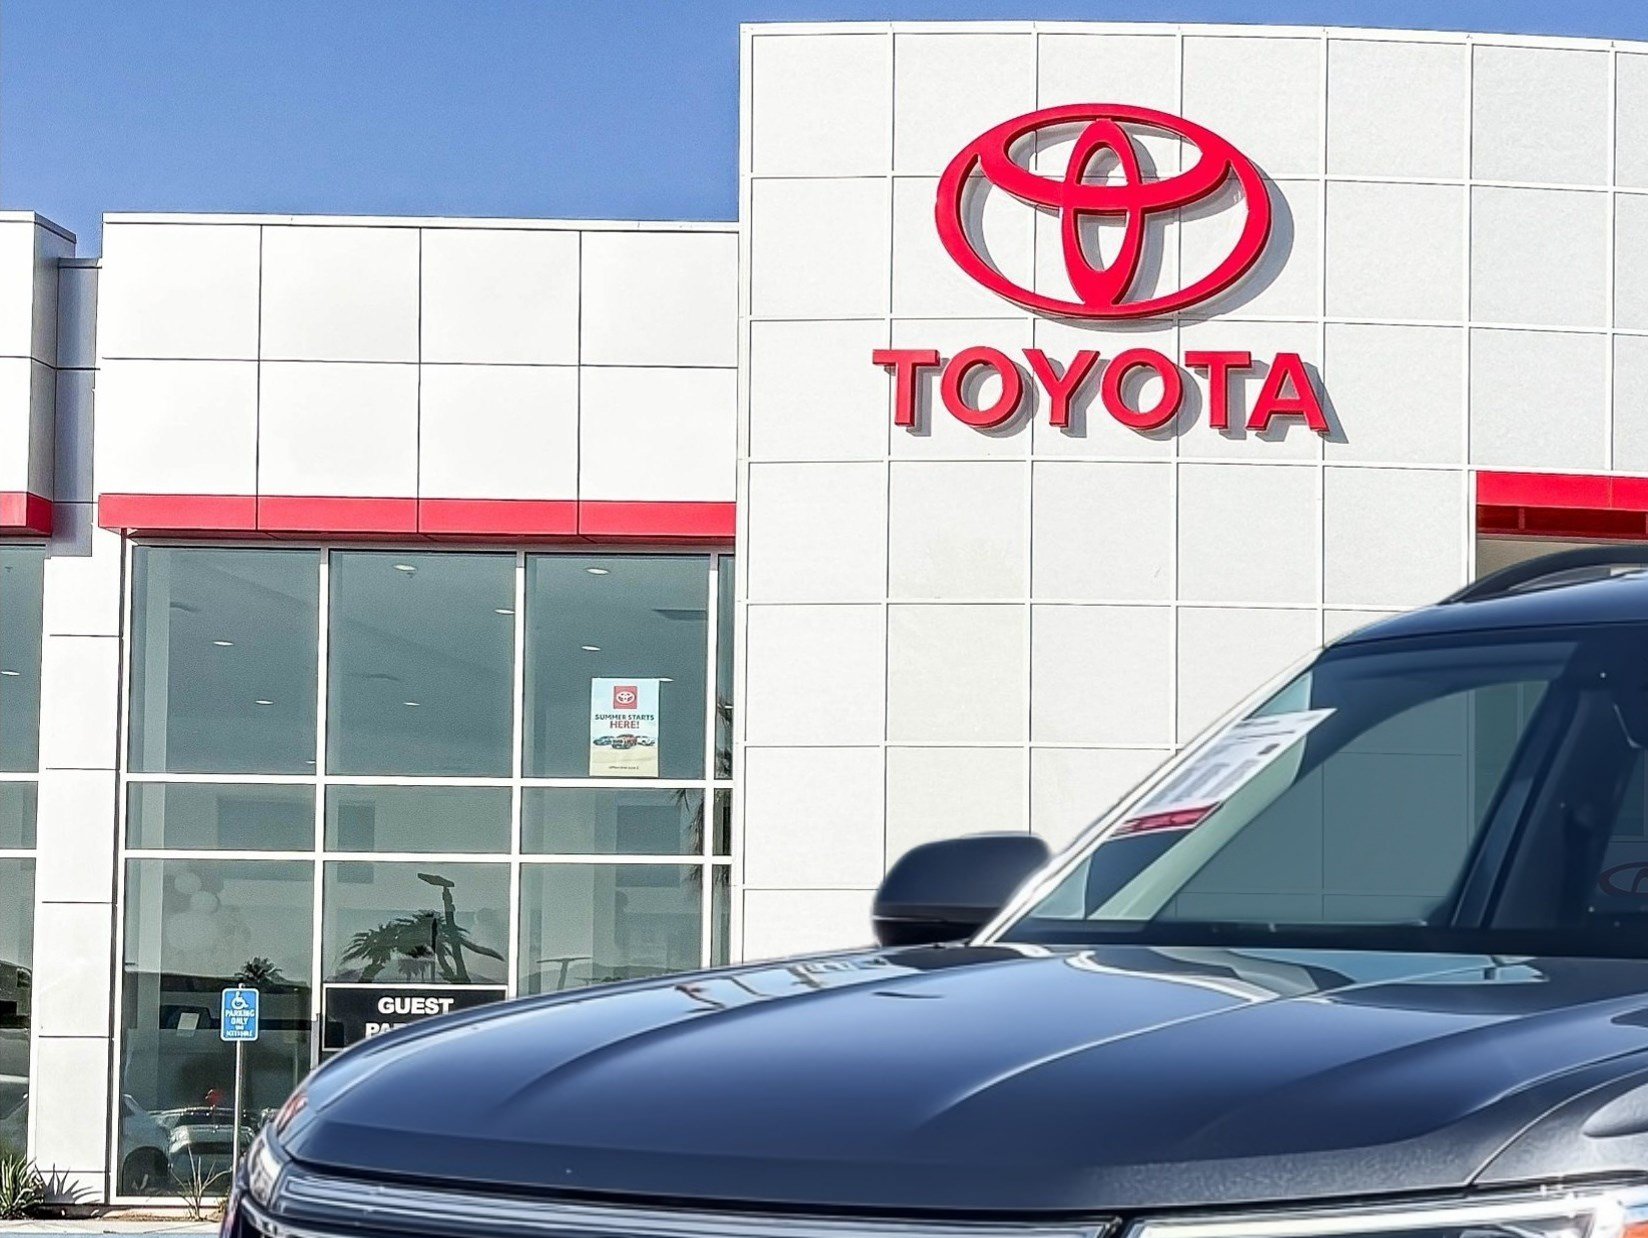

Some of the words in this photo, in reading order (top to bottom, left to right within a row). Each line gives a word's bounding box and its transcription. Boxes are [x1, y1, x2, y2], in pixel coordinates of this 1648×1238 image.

[873, 345, 1329, 432] TOYOTA
[610, 720, 640, 729] HERE!
[377, 996, 455, 1015] GUEST
